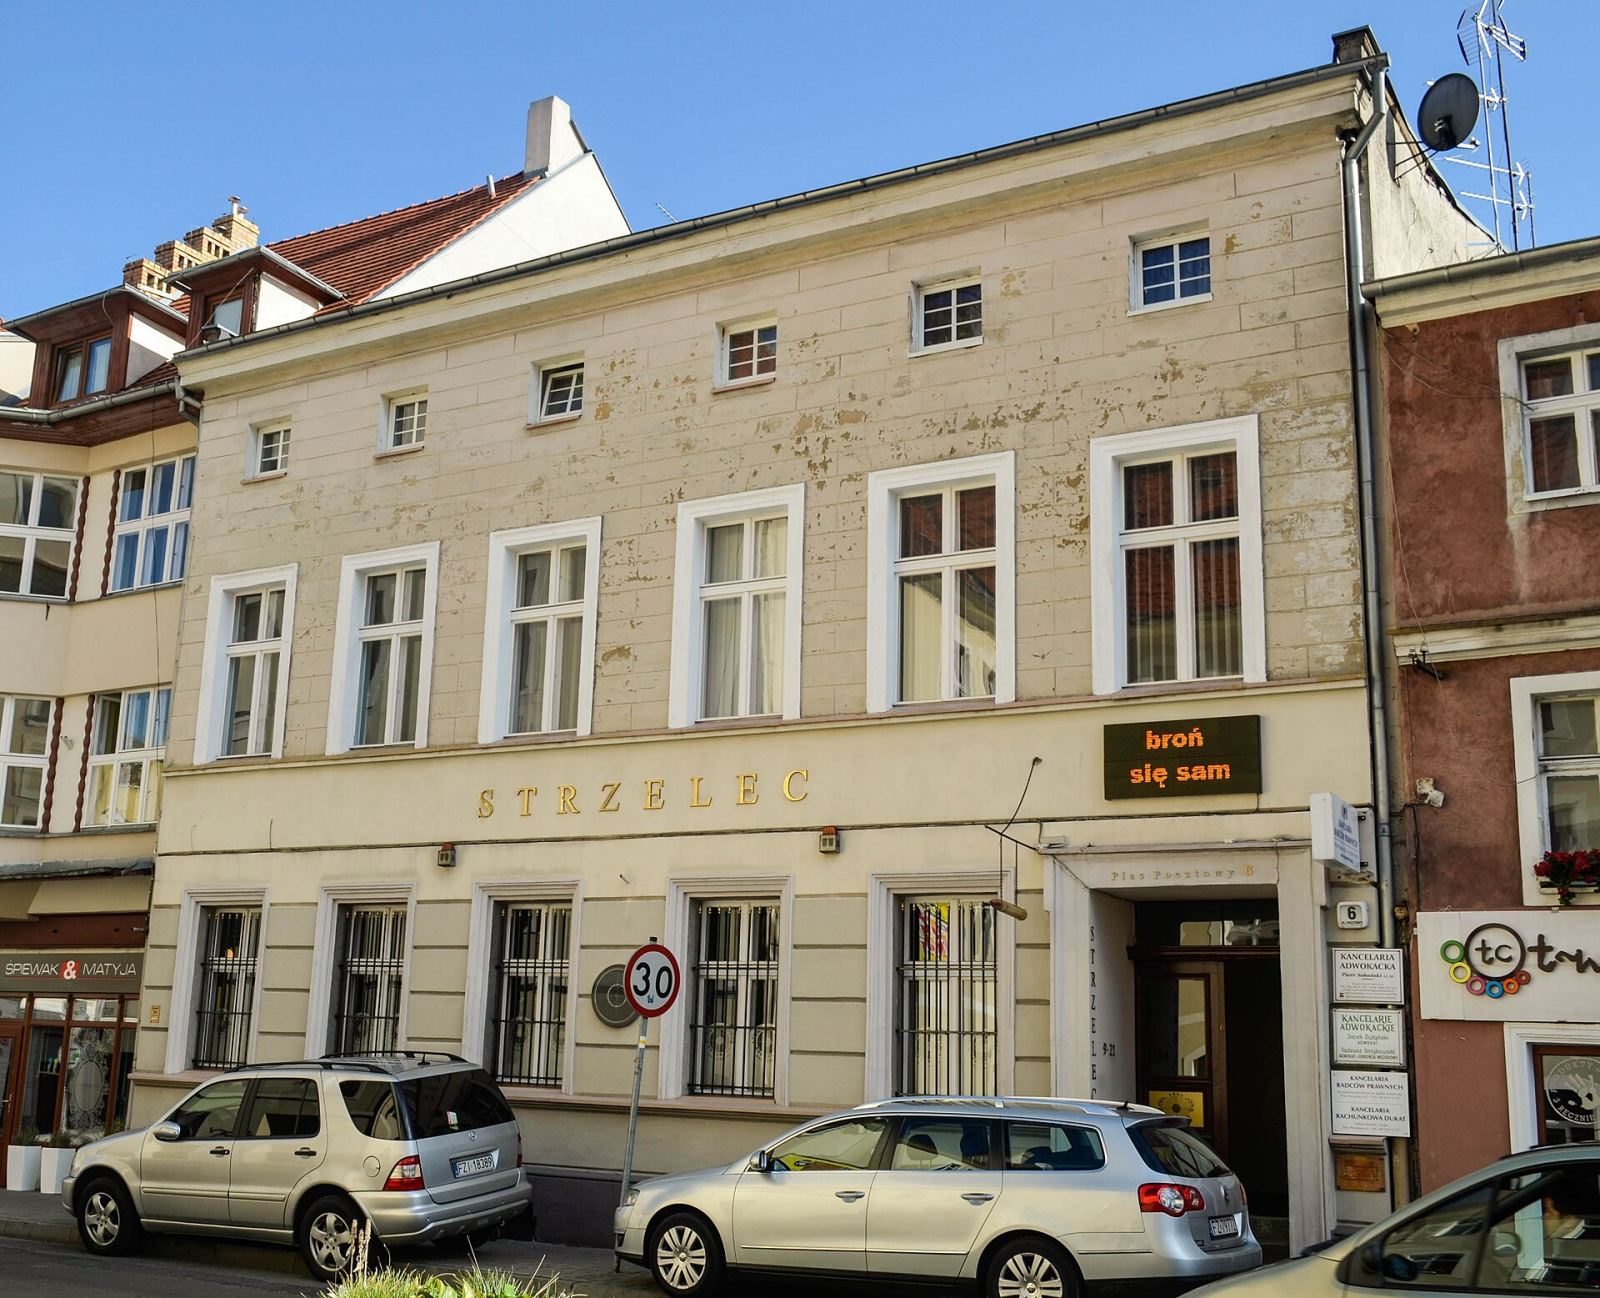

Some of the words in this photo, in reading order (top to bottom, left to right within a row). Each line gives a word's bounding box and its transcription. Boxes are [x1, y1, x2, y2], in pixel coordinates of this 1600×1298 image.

[1146, 727, 1204, 750] broń
[1130, 763, 1168, 788] się
[1176, 764, 1231, 782] sam
[478, 768, 809, 818] STRZELEC
[1111, 872, 1145, 881] Plac
[1347, 906, 1356, 920] 6
[1340, 953, 1395, 961] KANCELARIA
[1475, 938, 1513, 965] tc
[5, 960, 59, 976] ŚPIEWAK
[63, 960, 77, 980] &
[82, 963, 137, 976] MATYJA
[1339, 962, 1396, 971] ADWOKACKA
[633, 962, 673, 999] 30
[1342, 1014, 1392, 1024] KANCELARIE
[1340, 1023, 1395, 1032] ADWOKACKIE
[1336, 1113, 1383, 1121] RACHUNKOWA
